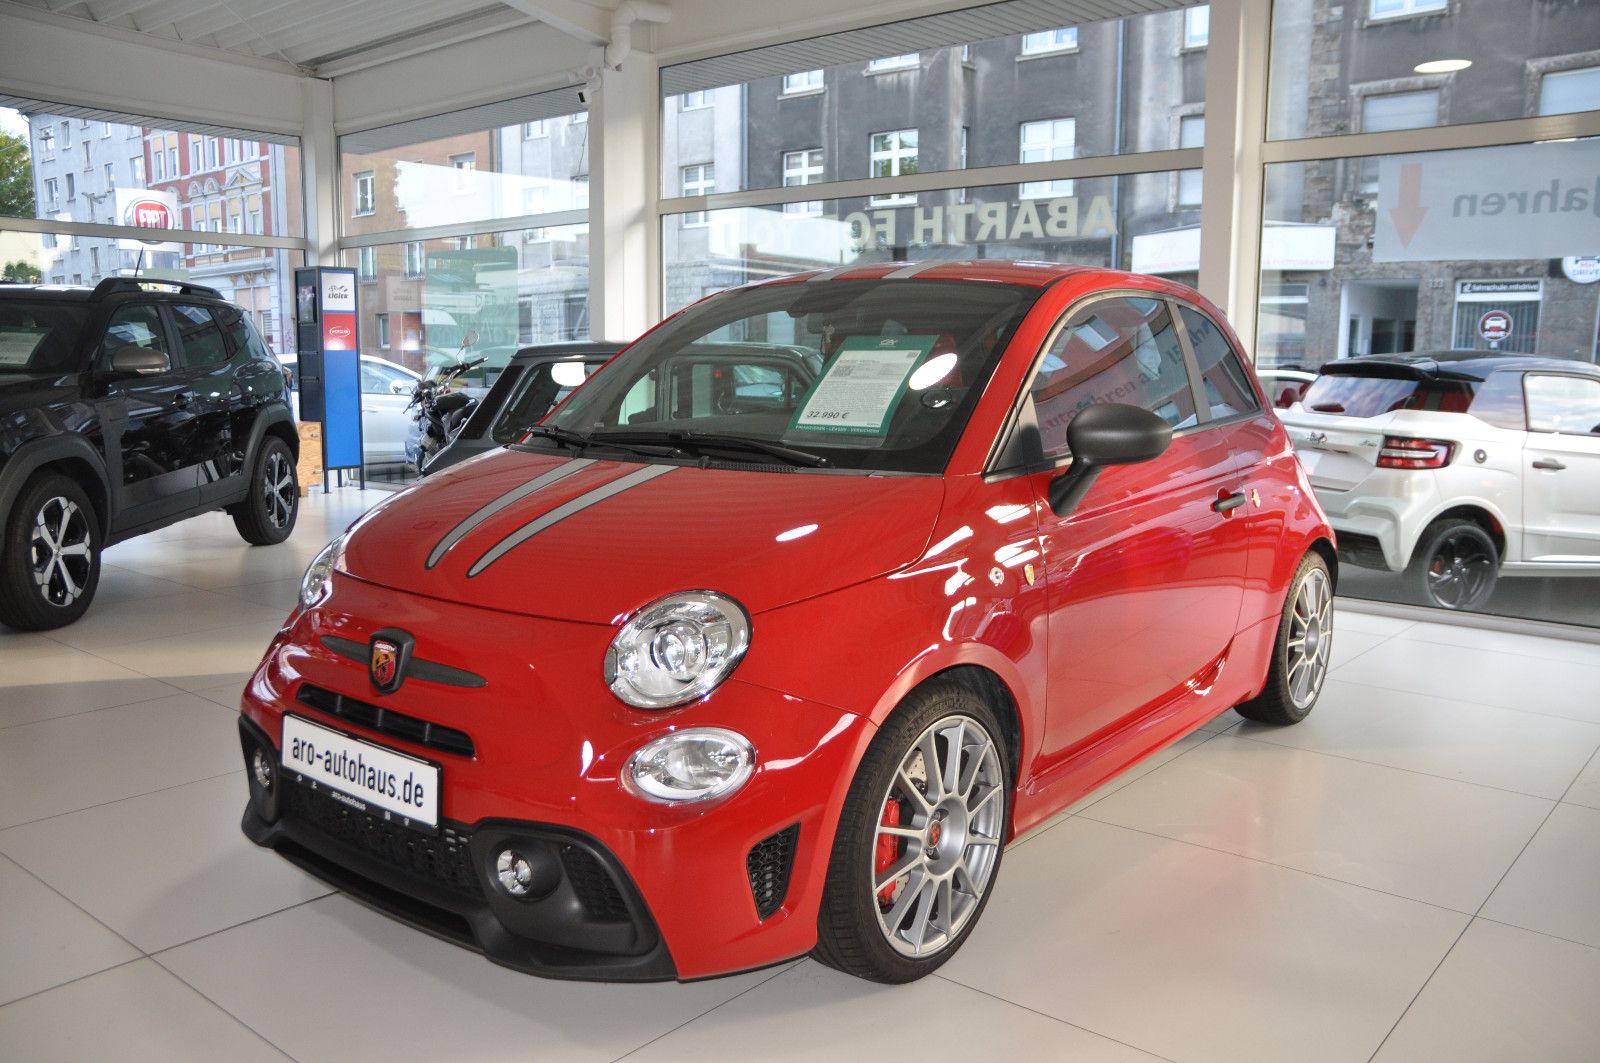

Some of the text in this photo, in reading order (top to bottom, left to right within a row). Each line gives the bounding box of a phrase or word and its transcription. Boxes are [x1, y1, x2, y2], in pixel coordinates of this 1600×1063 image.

[138, 208, 167, 228] FIAT
[807, 410, 850, 419] 32.990 €
[292, 737, 424, 808] aro-autohaus.de
